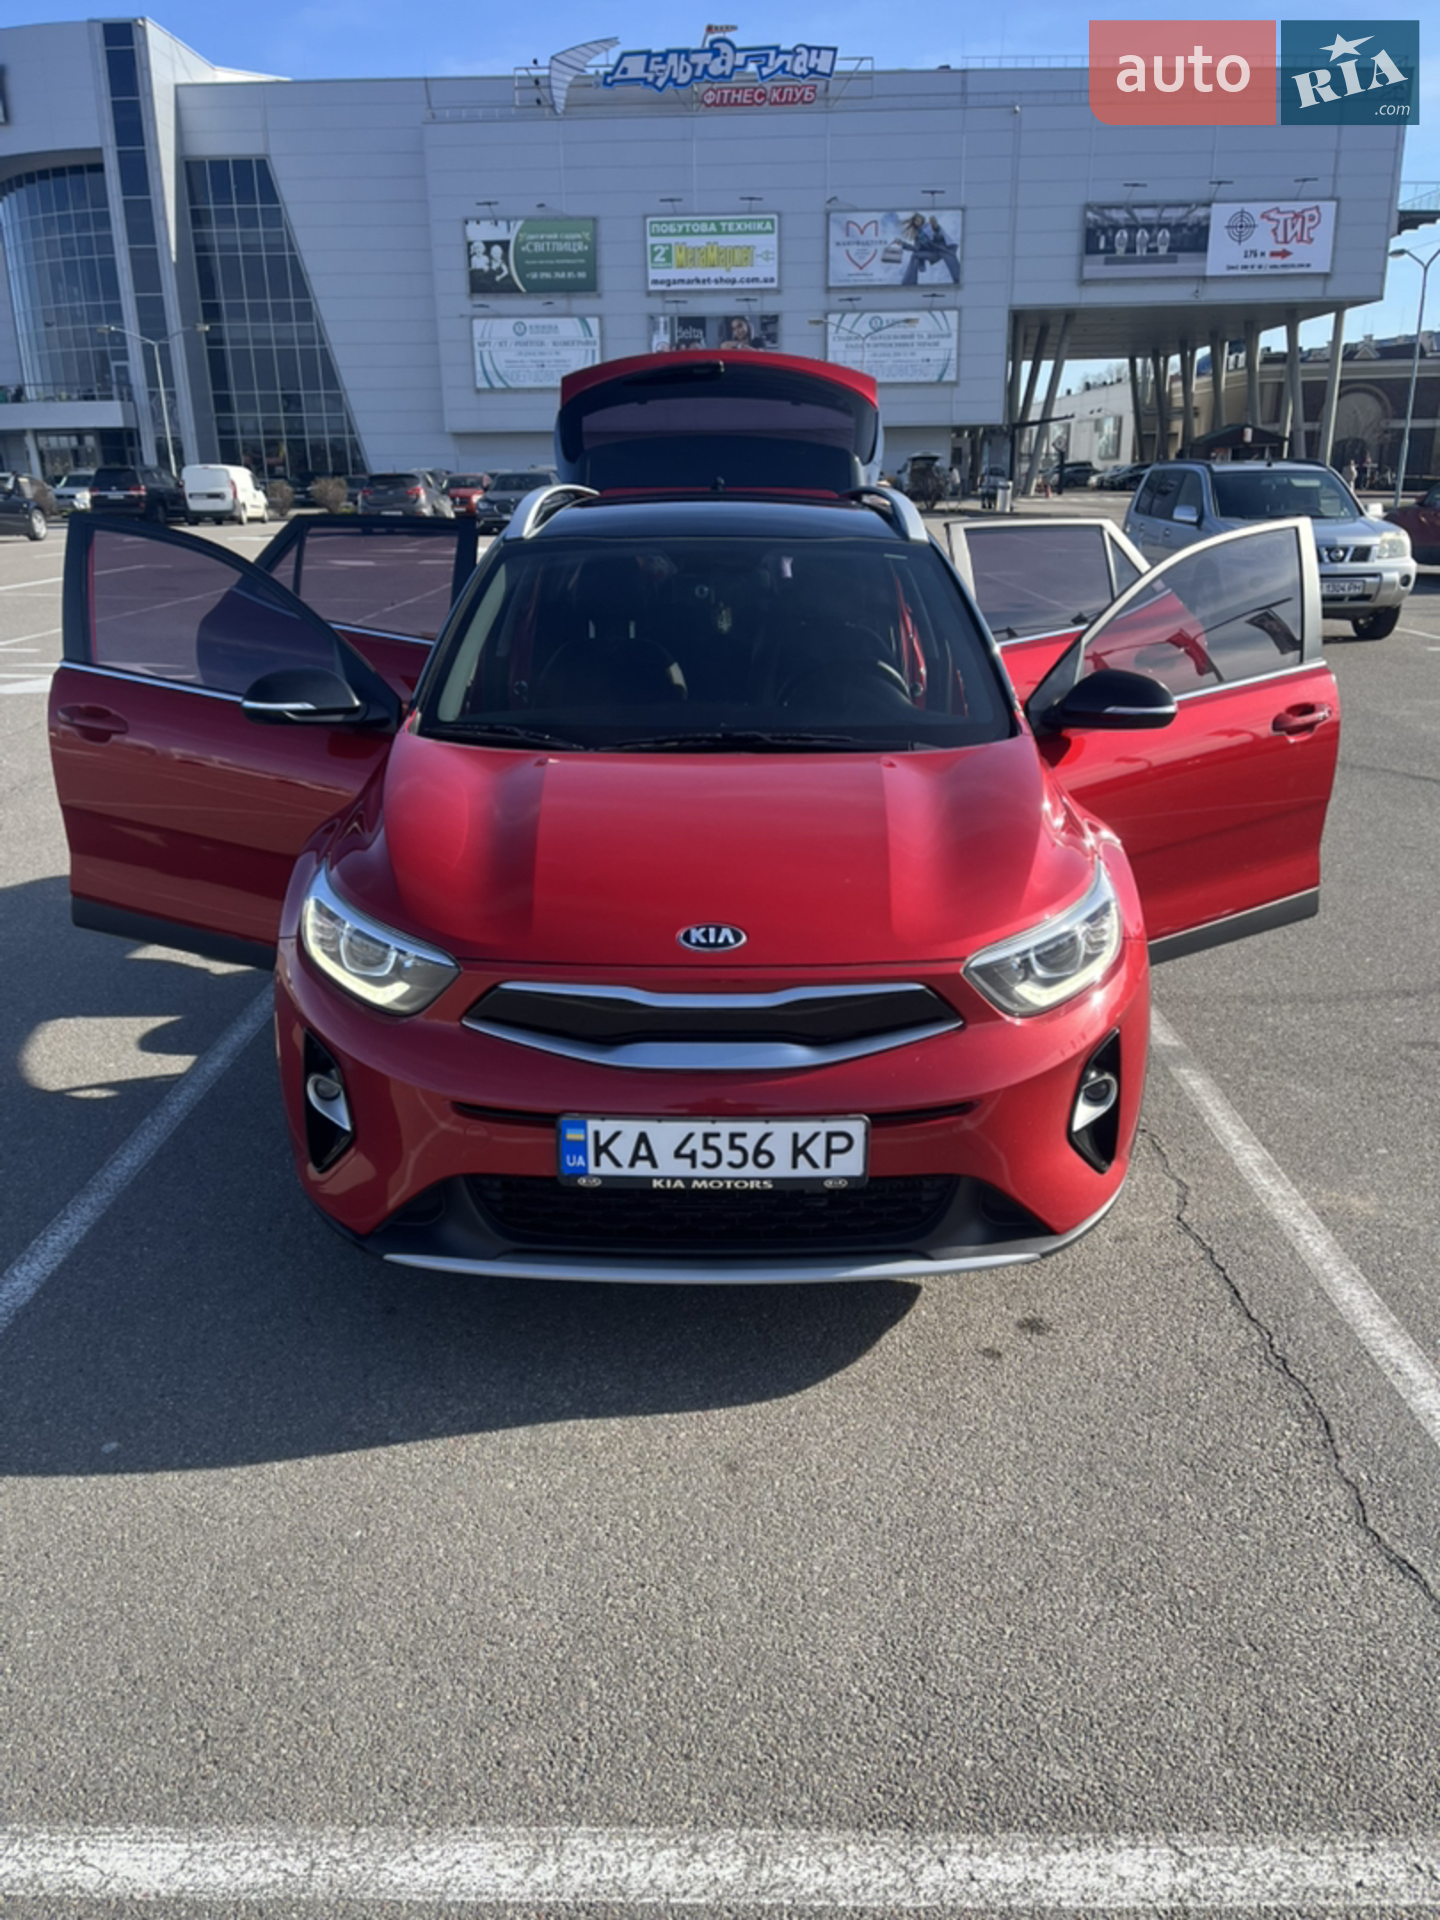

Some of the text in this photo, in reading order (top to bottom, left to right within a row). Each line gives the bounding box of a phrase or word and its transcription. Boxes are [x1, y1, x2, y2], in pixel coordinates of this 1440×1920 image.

[703, 86, 816, 105] ФІТНЕС КЛУБ
[651, 220, 774, 234] ПОБУТОВА ТЕХНІКА
[650, 276, 776, 288] megamarket-shop.com.ua
[676, 324, 704, 340] delta
[690, 927, 735, 944] KIA
[593, 1130, 855, 1170] KA 4556 KP
[566, 1154, 586, 1167] UA
[652, 1178, 774, 1190] KIA MOTORS
